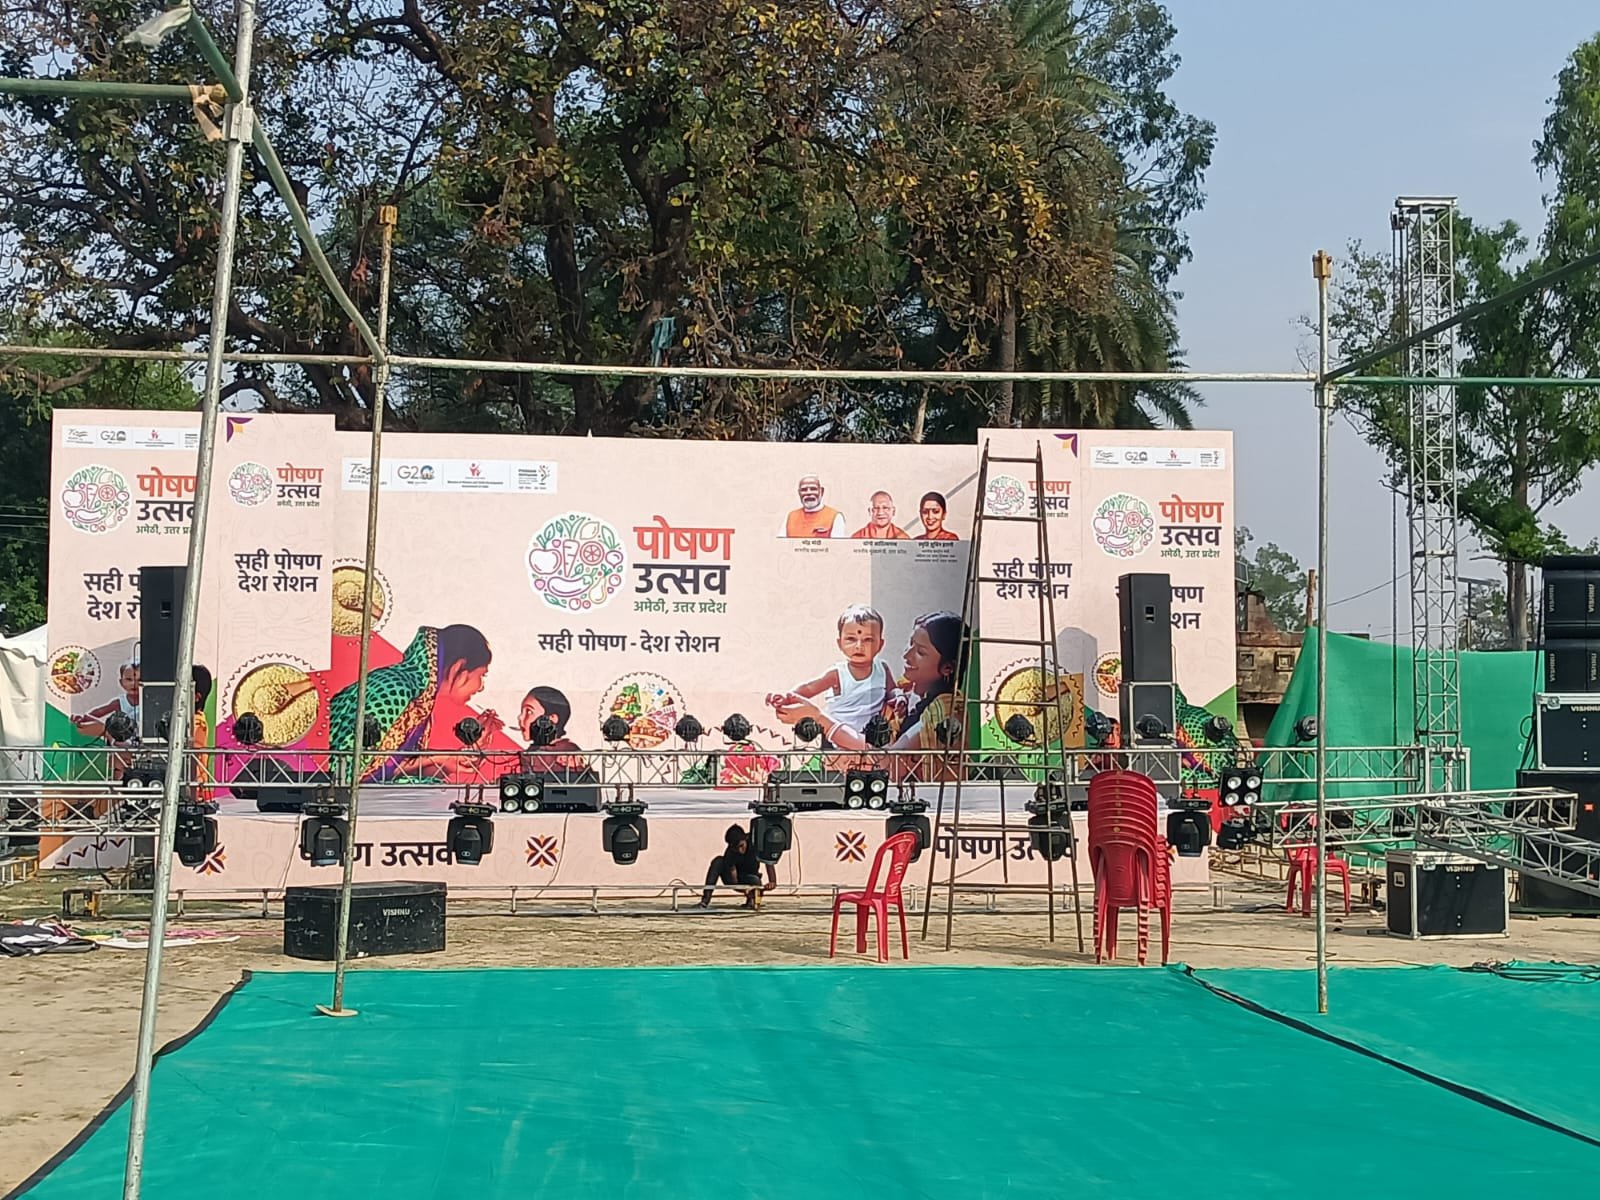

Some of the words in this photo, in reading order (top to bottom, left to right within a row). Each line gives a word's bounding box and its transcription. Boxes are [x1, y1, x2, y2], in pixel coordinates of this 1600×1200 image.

[276, 462, 324, 483] पोषण
[276, 484, 322, 499] उत्सव
[1159, 494, 1224, 523] पोषण
[633, 515, 735, 560] पोषण
[1159, 526, 1222, 546] उत्सव
[234, 548, 270, 572] सही
[274, 548, 323, 570] पोषण
[992, 557, 1024, 580] सही
[83, 567, 123, 594] सही
[238, 570, 268, 592] देश
[272, 570, 319, 592] रोशन
[632, 563, 731, 595] उत्सव
[86, 594, 122, 620] देश
[633, 597, 669, 614] अमेठी,
[672, 601, 697, 613] उत्तर
[699, 598, 727, 614] प्रदेश
[538, 628, 572, 653] सही
[578, 628, 627, 652] पोषण
[640, 629, 671, 653] देश
[674, 630, 721, 653] रोशन
[1445, 865, 1475, 873] VISHNU
[382, 908, 410, 917] VISHNU
